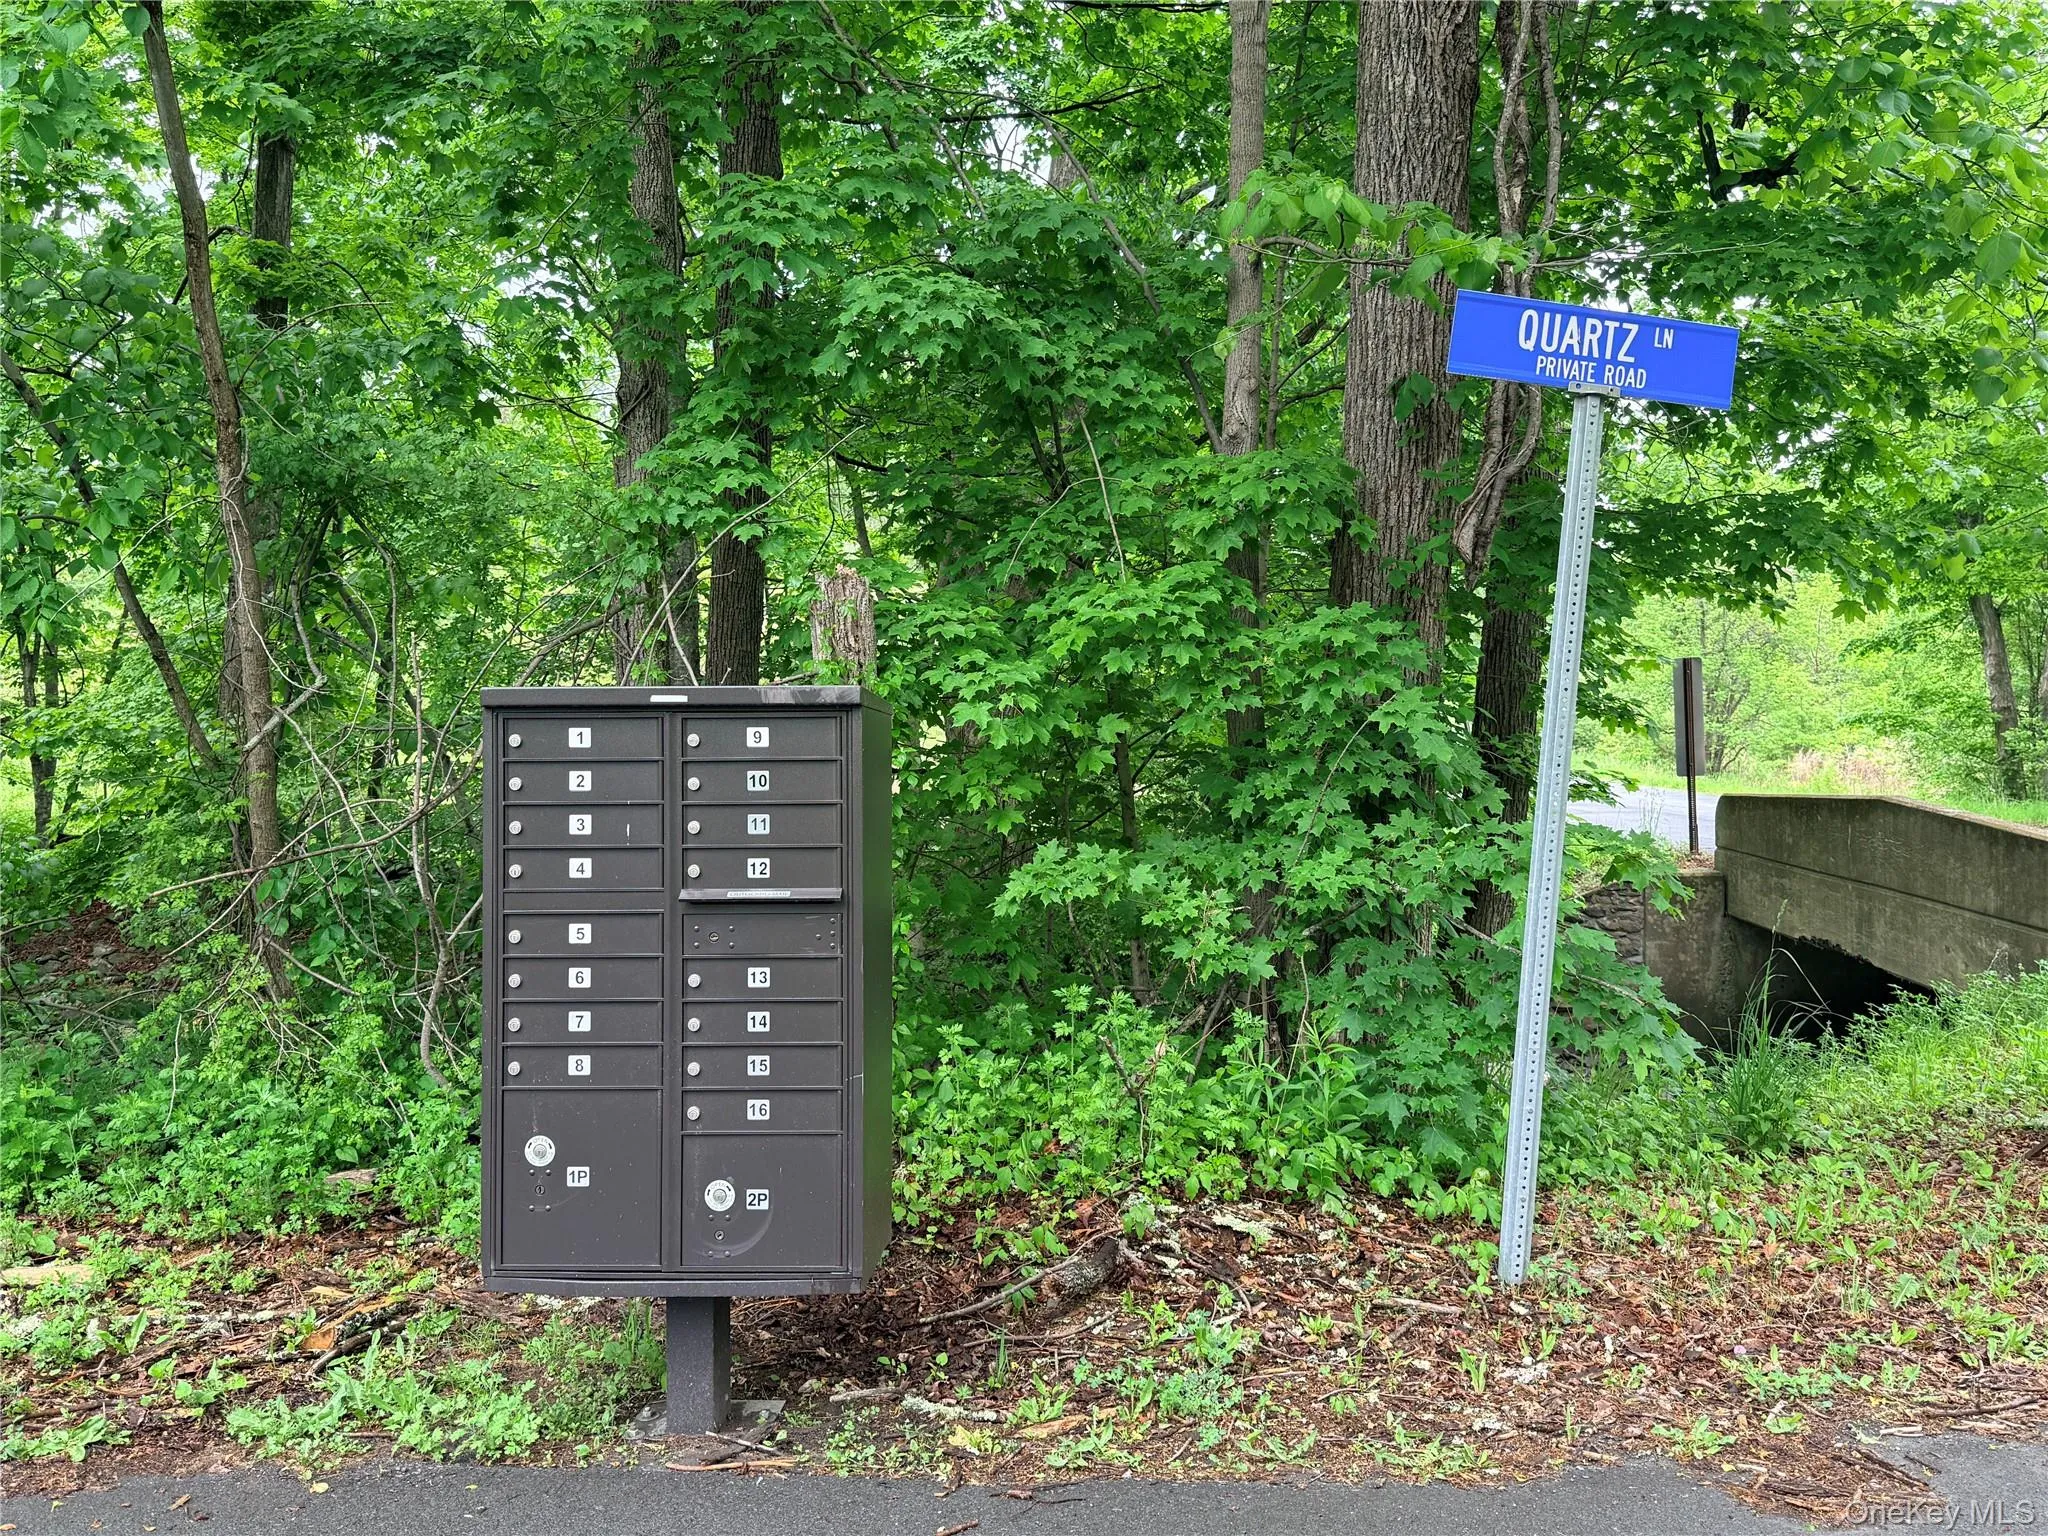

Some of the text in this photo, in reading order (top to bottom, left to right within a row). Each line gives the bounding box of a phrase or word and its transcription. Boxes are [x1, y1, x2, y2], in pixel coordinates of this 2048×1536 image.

[1518, 309, 1674, 363] QUARTZ LN
[1536, 356, 1647, 389] PRIVATE ROAD
[575, 731, 583, 745] 1
[753, 730, 762, 744] 9
[576, 774, 585, 788] 2
[749, 774, 768, 788] 10
[576, 818, 585, 832] 3
[751, 817, 767, 831] 11
[576, 862, 585, 875] 4
[750, 861, 768, 876] 12
[576, 927, 585, 940] 5
[575, 970, 584, 985] 6
[750, 970, 768, 984] 13
[575, 1015, 584, 1029] 7
[750, 1015, 768, 1029] 14
[575, 1058, 584, 1072] 8
[749, 1059, 768, 1073] 15
[749, 1103, 768, 1117] 16
[568, 1170, 588, 1184] 1P
[747, 1192, 768, 1207] 2P
